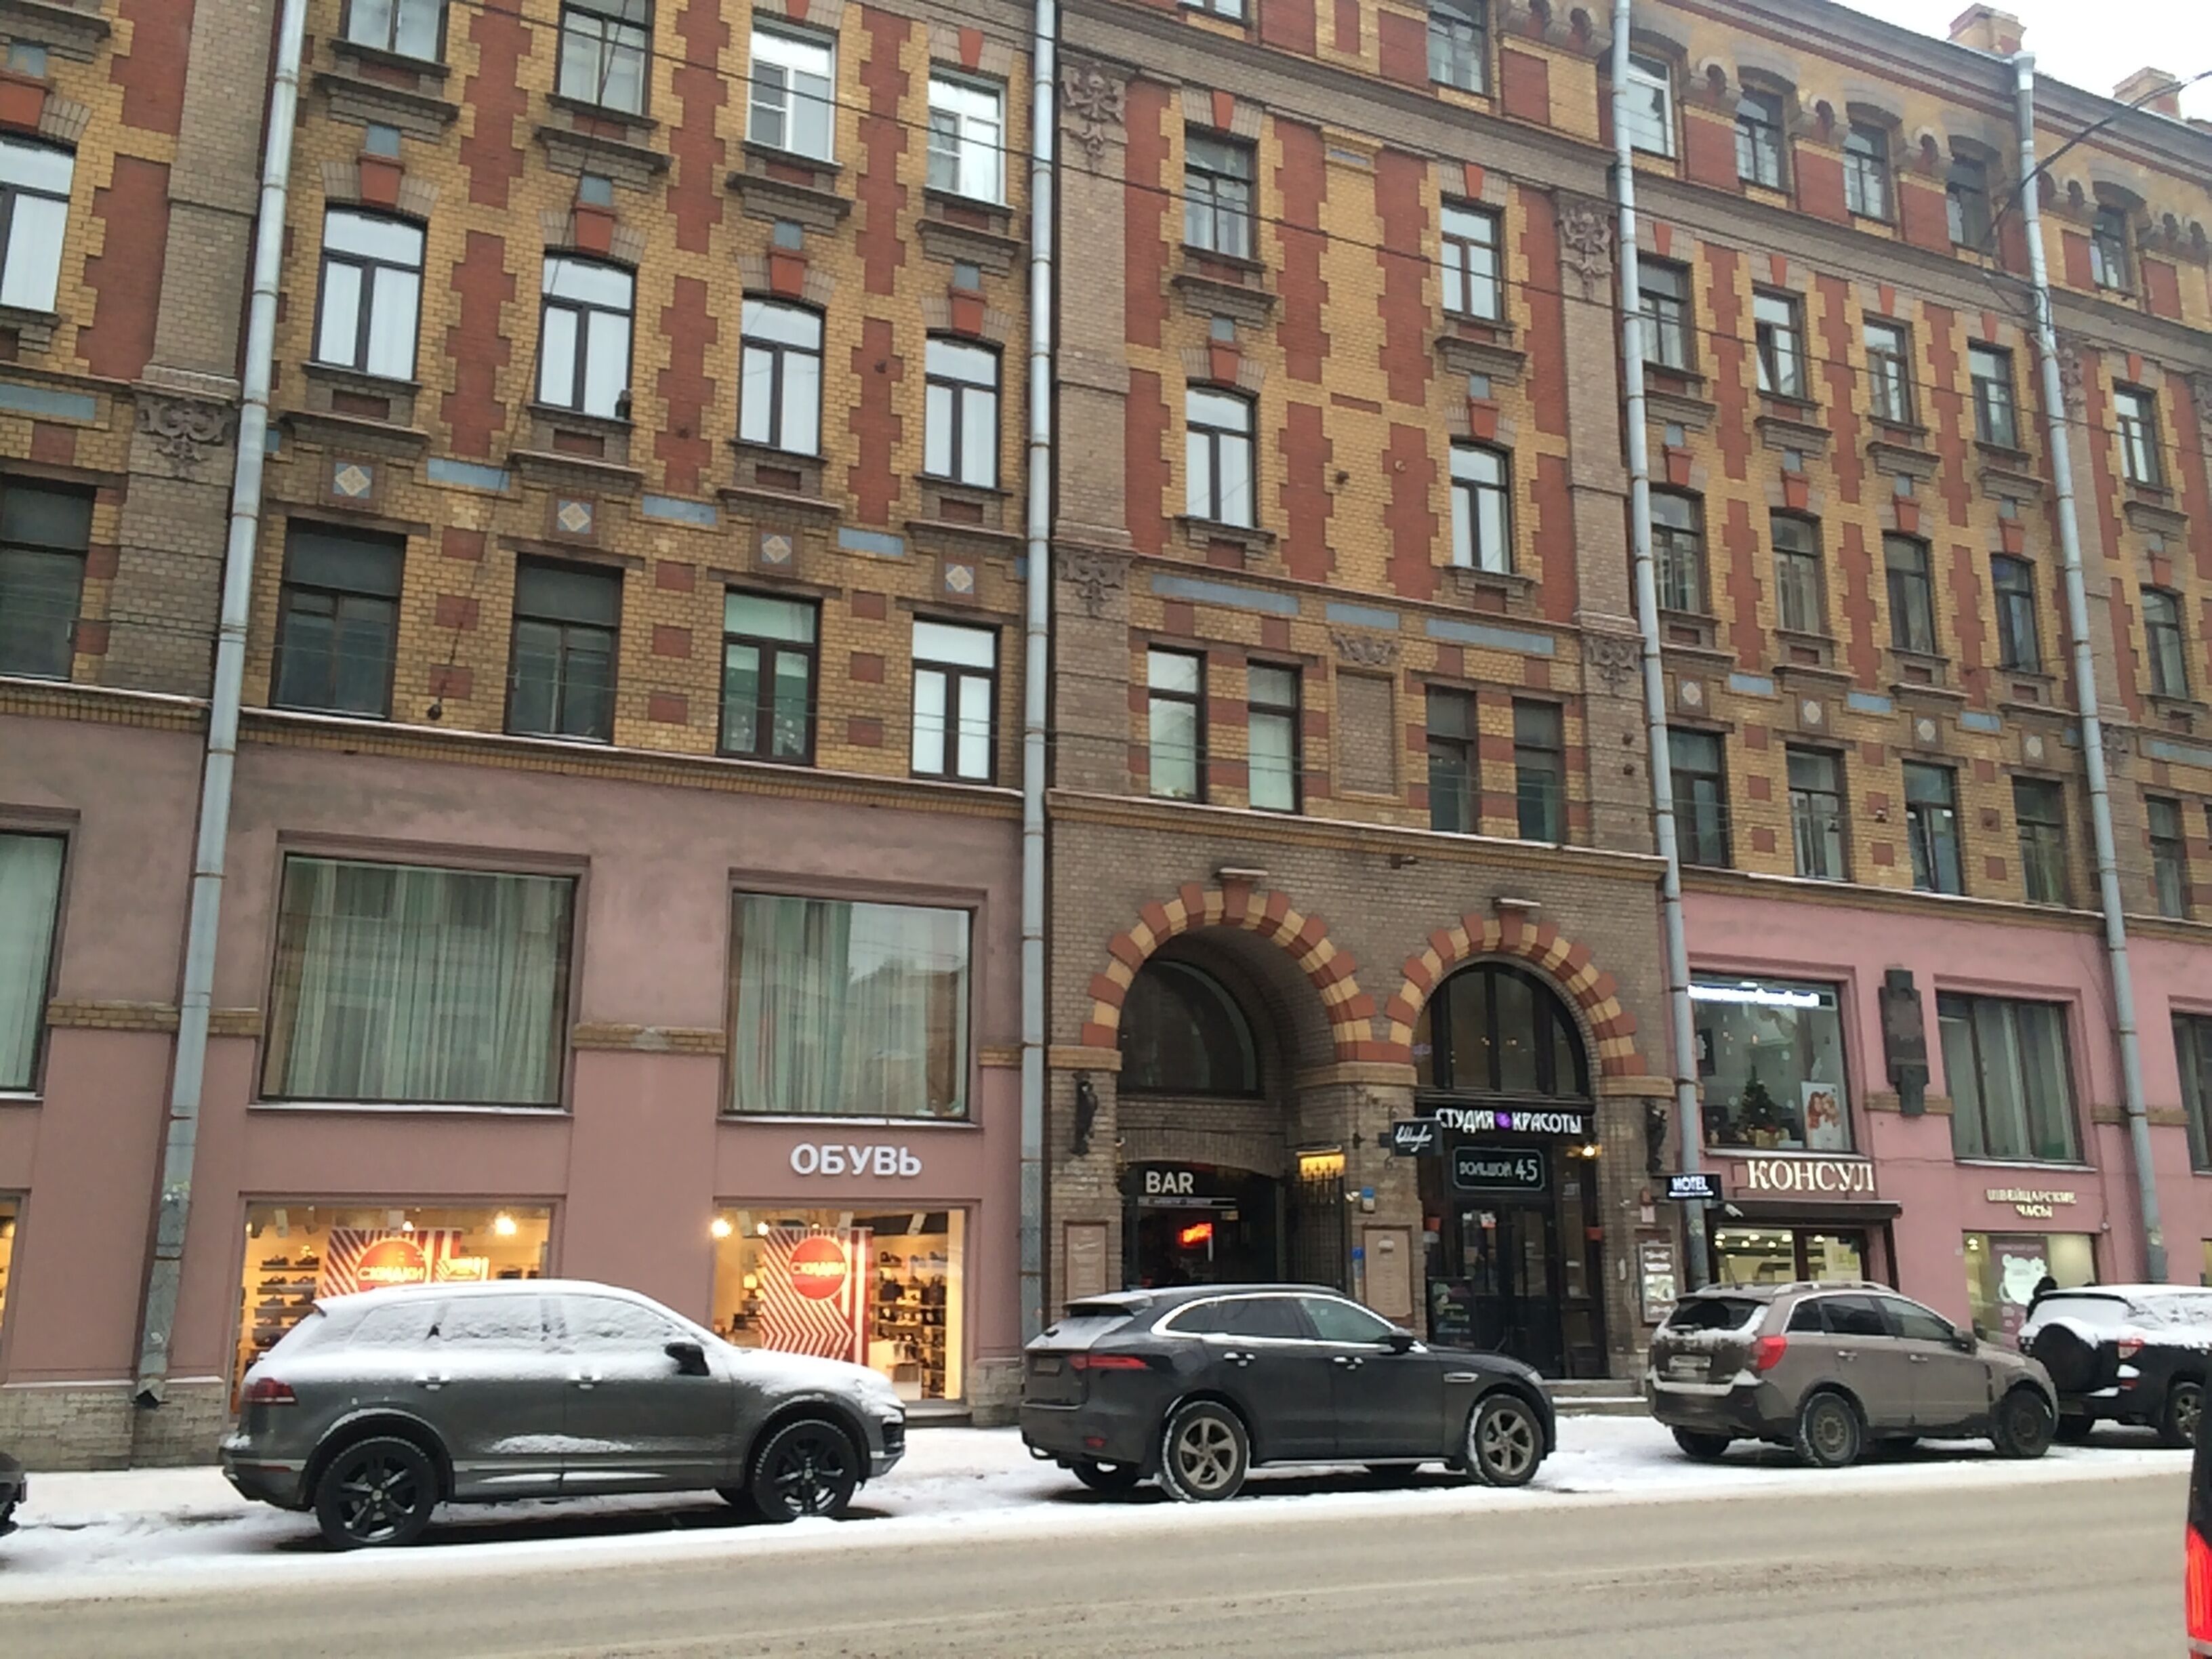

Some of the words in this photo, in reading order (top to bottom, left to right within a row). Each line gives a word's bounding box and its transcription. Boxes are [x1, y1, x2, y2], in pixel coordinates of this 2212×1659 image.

[1436, 1108, 1495, 1134] СТУДИЯ
[1511, 1111, 1582, 1134] КРАСОТЫ
[790, 1143, 922, 1176] ОБУВЬ
[1515, 1158, 1538, 1181] 45
[1145, 1170, 1194, 1194] BAR
[1672, 1175, 1708, 1191] HOTEL
[1747, 1160, 1875, 1192] КОНСУЛ
[2015, 1204, 2053, 1218] ЧАСЫ
[357, 1266, 424, 1283] СКИДКИ
